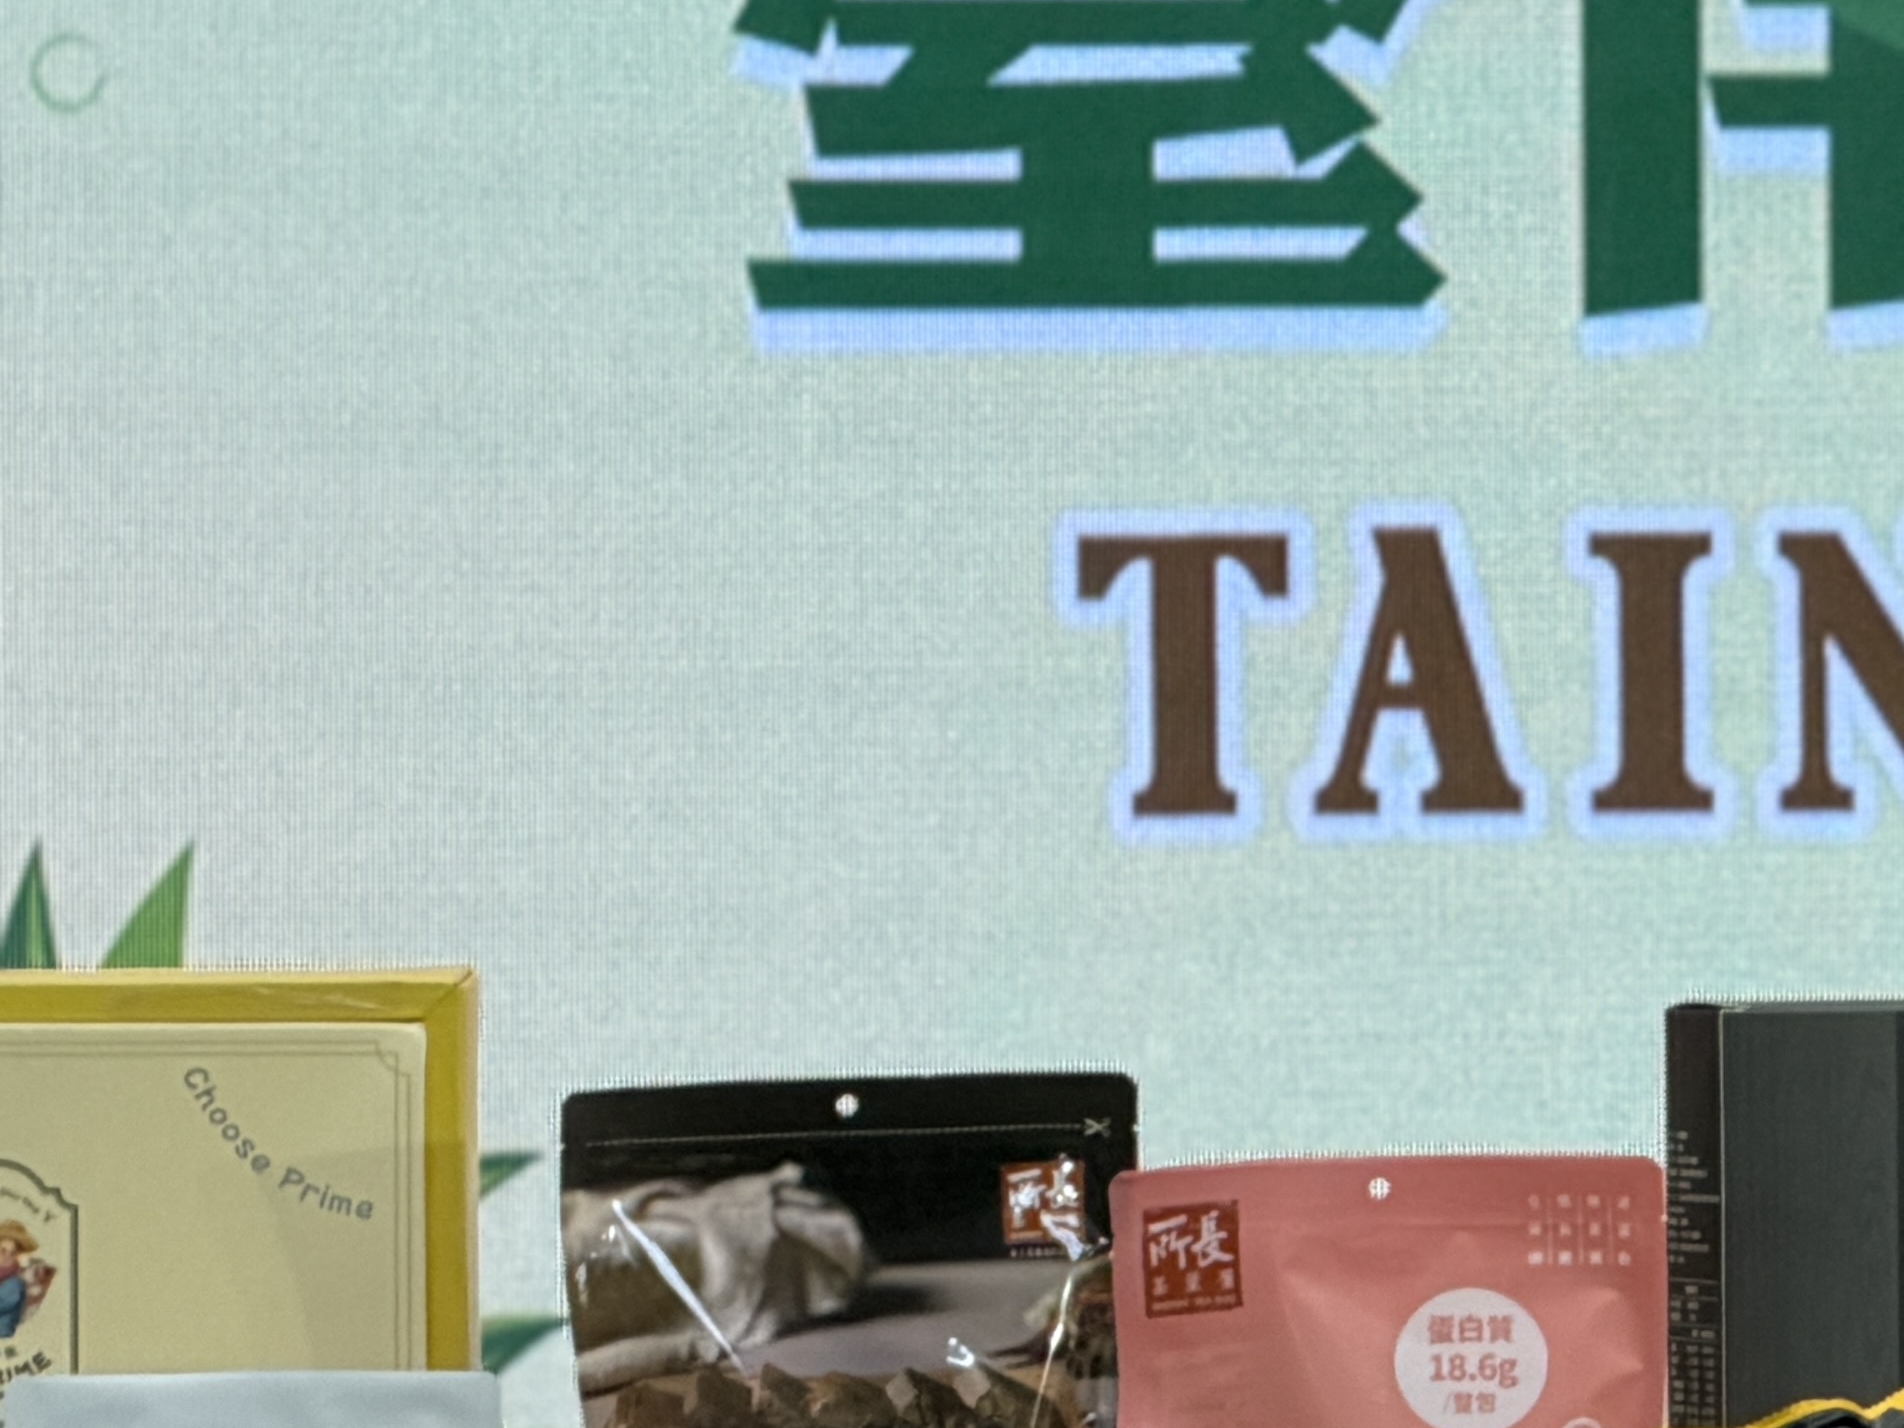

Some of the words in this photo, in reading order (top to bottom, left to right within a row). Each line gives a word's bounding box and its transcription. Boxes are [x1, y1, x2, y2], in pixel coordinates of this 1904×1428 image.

[183, 1067, 271, 1175] Choose
[278, 1166, 374, 1221] Prime
[1427, 1314, 1515, 1346] 蛋白質
[1429, 1352, 1520, 1389] 18.6g
